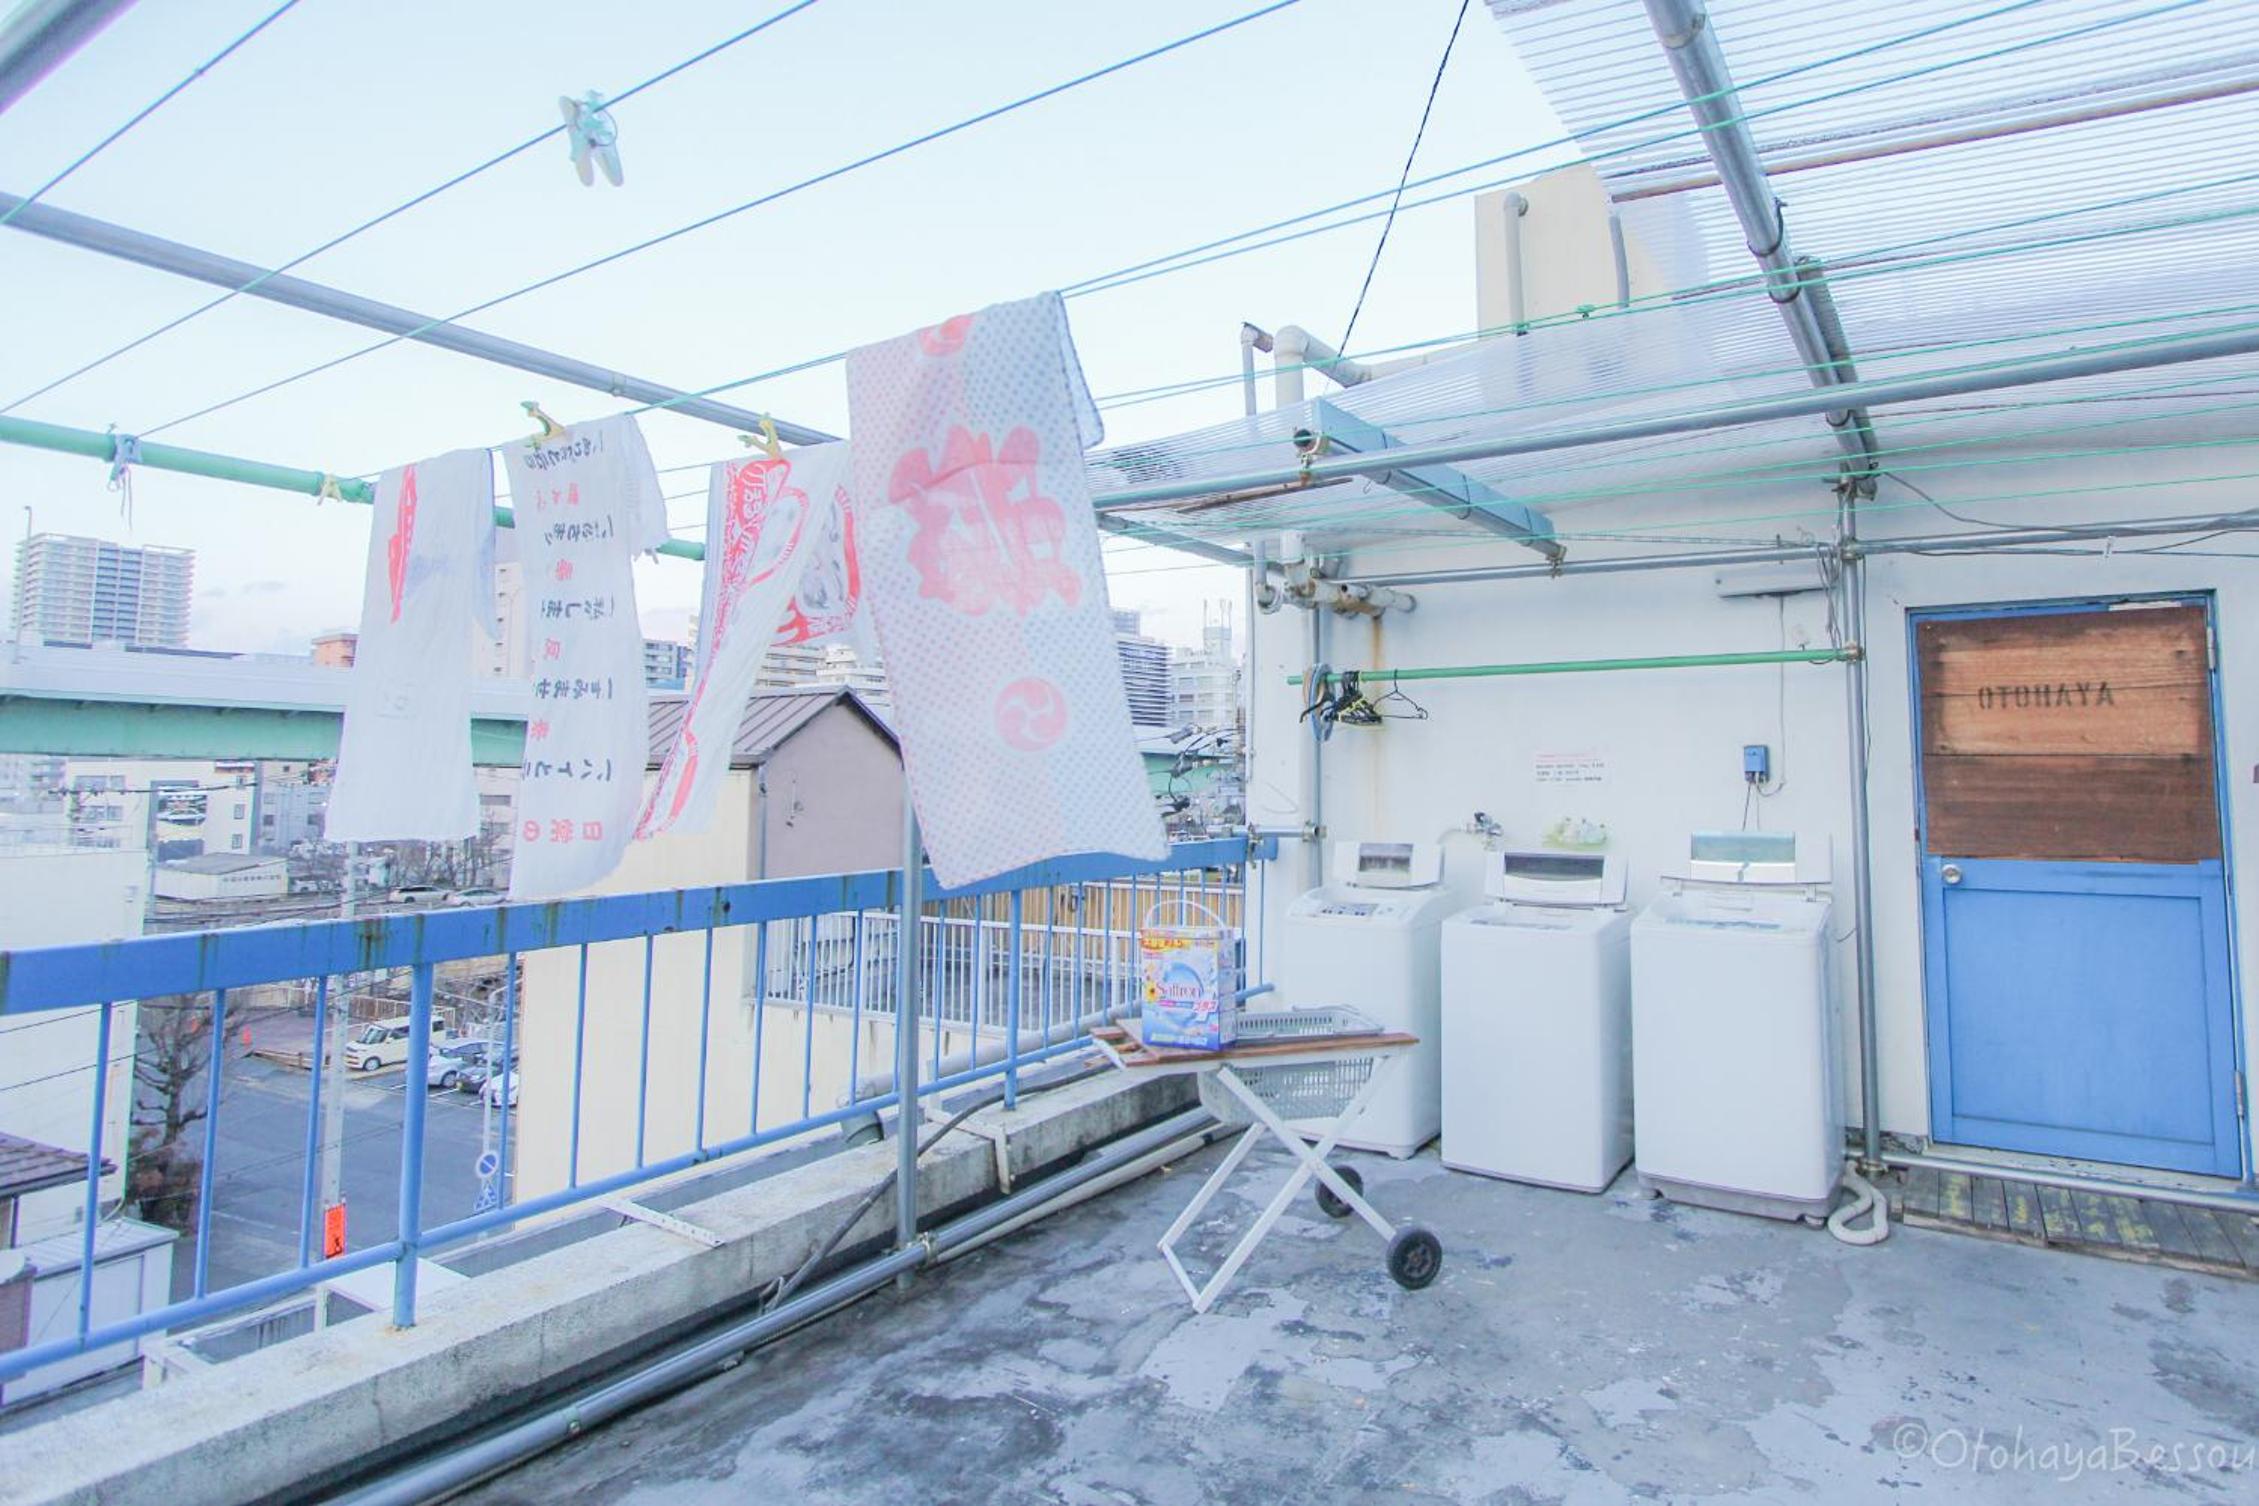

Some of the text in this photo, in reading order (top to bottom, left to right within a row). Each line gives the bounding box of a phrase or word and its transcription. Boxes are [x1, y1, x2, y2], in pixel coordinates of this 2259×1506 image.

[1977, 681, 2115, 710] OTOHAYA
[522, 818, 604, 843] 日常の
